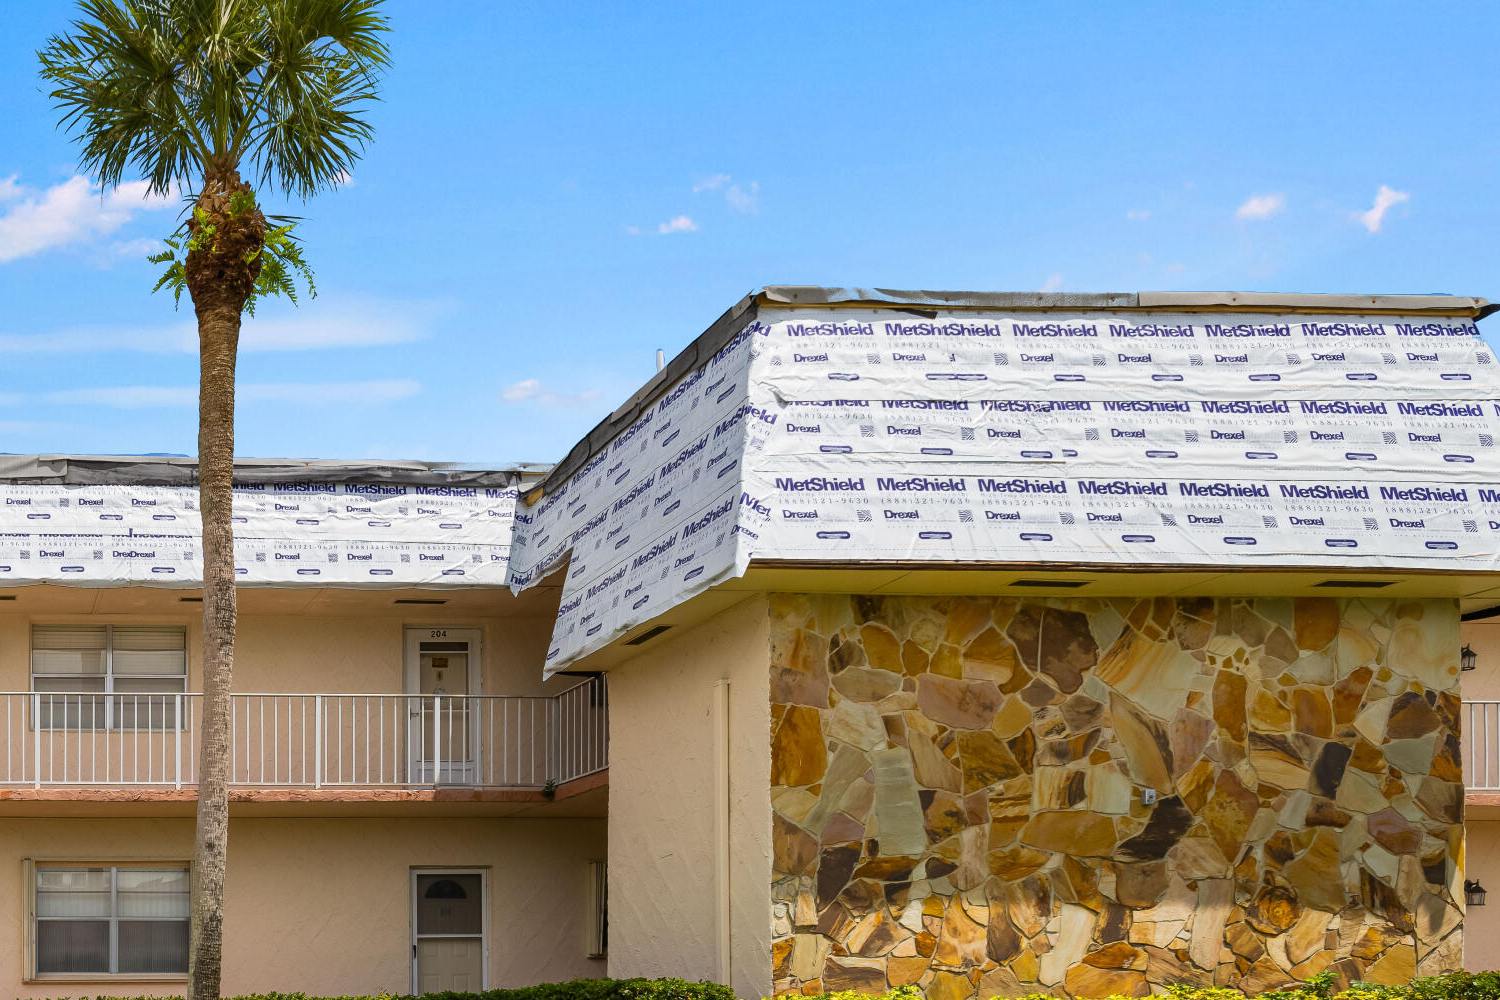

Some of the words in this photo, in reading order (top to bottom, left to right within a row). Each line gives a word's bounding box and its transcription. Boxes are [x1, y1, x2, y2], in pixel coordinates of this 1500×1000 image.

[787, 323, 873, 336] MetShield
[1012, 324, 1098, 337] MetShield
[1110, 324, 1194, 338] MetShield
[1205, 324, 1290, 337] MetShield
[1302, 323, 1386, 336] MetShield
[1395, 323, 1480, 336] MetShield
[794, 353, 828, 362] Drexel
[1020, 353, 1054, 362] Drexel
[1118, 353, 1152, 362] Drexel
[1214, 354, 1248, 362] Drexel
[1312, 352, 1346, 362] Drexel
[1406, 353, 1438, 362] Drexel
[1103, 400, 1190, 412] MetShield
[1202, 401, 1290, 414] MetShield
[1300, 402, 1388, 414] MetShield
[1397, 402, 1484, 417] MetShield
[786, 424, 820, 433] Drexel
[887, 426, 921, 436] Drexel
[987, 429, 1021, 438] Drexel
[1111, 428, 1146, 438] Drexel
[1210, 430, 1245, 440] Drexel
[1310, 431, 1344, 440] Drexel
[1408, 432, 1442, 442] Drexel
[273, 483, 336, 494] MetShield
[344, 484, 407, 496] MetShield
[776, 478, 865, 492] MetShield
[876, 478, 966, 492] MetShield
[978, 478, 1066, 494] MetShield
[1078, 480, 1168, 496] MetShield
[1179, 482, 1270, 498] MetShield
[416, 487, 478, 498] MetShield
[1280, 484, 1370, 500] MetShield
[1380, 486, 1468, 502] MetShield
[6, 498, 32, 506] Drexel
[78, 498, 104, 506] Drexel
[132, 498, 157, 506] Drexel
[275, 503, 300, 511] Drexel
[782, 509, 818, 519] Drexel
[884, 510, 920, 519] Drexel
[984, 510, 1021, 520] Drexel
[1086, 512, 1122, 522] Drexel
[1188, 514, 1224, 524] Drexel
[1289, 516, 1325, 526] Drexel
[1389, 518, 1425, 528] Drexel
[39, 550, 65, 558] Drexel
[275, 552, 300, 560] Drexel
[431, 630, 447, 638] 204
